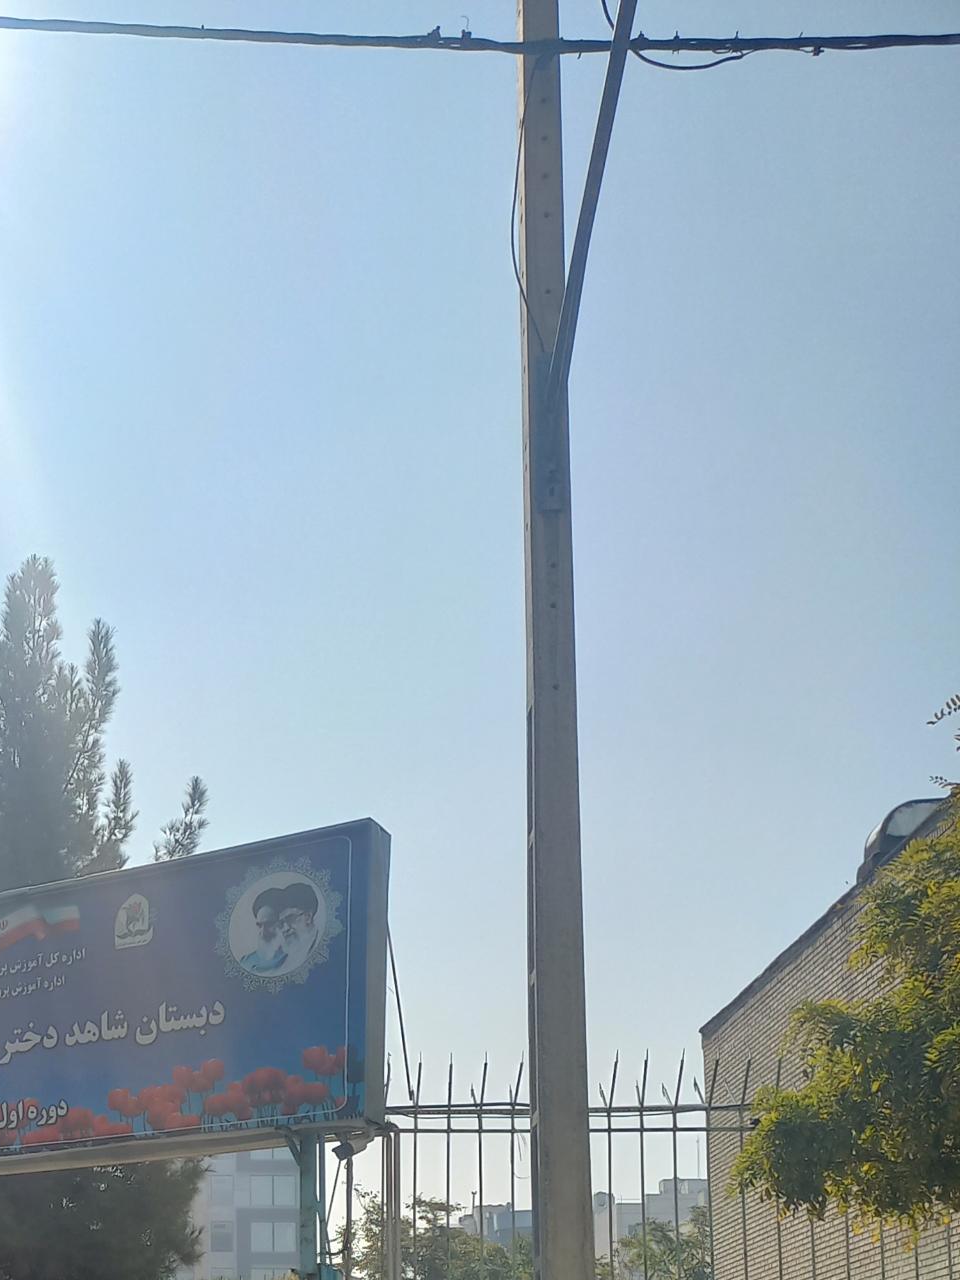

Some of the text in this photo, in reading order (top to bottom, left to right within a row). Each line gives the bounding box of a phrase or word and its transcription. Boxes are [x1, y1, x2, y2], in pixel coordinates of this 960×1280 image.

[10, 953, 43, 973] آموزش
[45, 952, 60, 968] کل
[61, 948, 86, 965] اداره
[11, 977, 42, 996] آموزش
[43, 975, 66, 991] اداره
[64, 1009, 129, 1047] شاهد
[135, 1000, 225, 1045] دبستان
[27, 1099, 69, 1126] دوره
